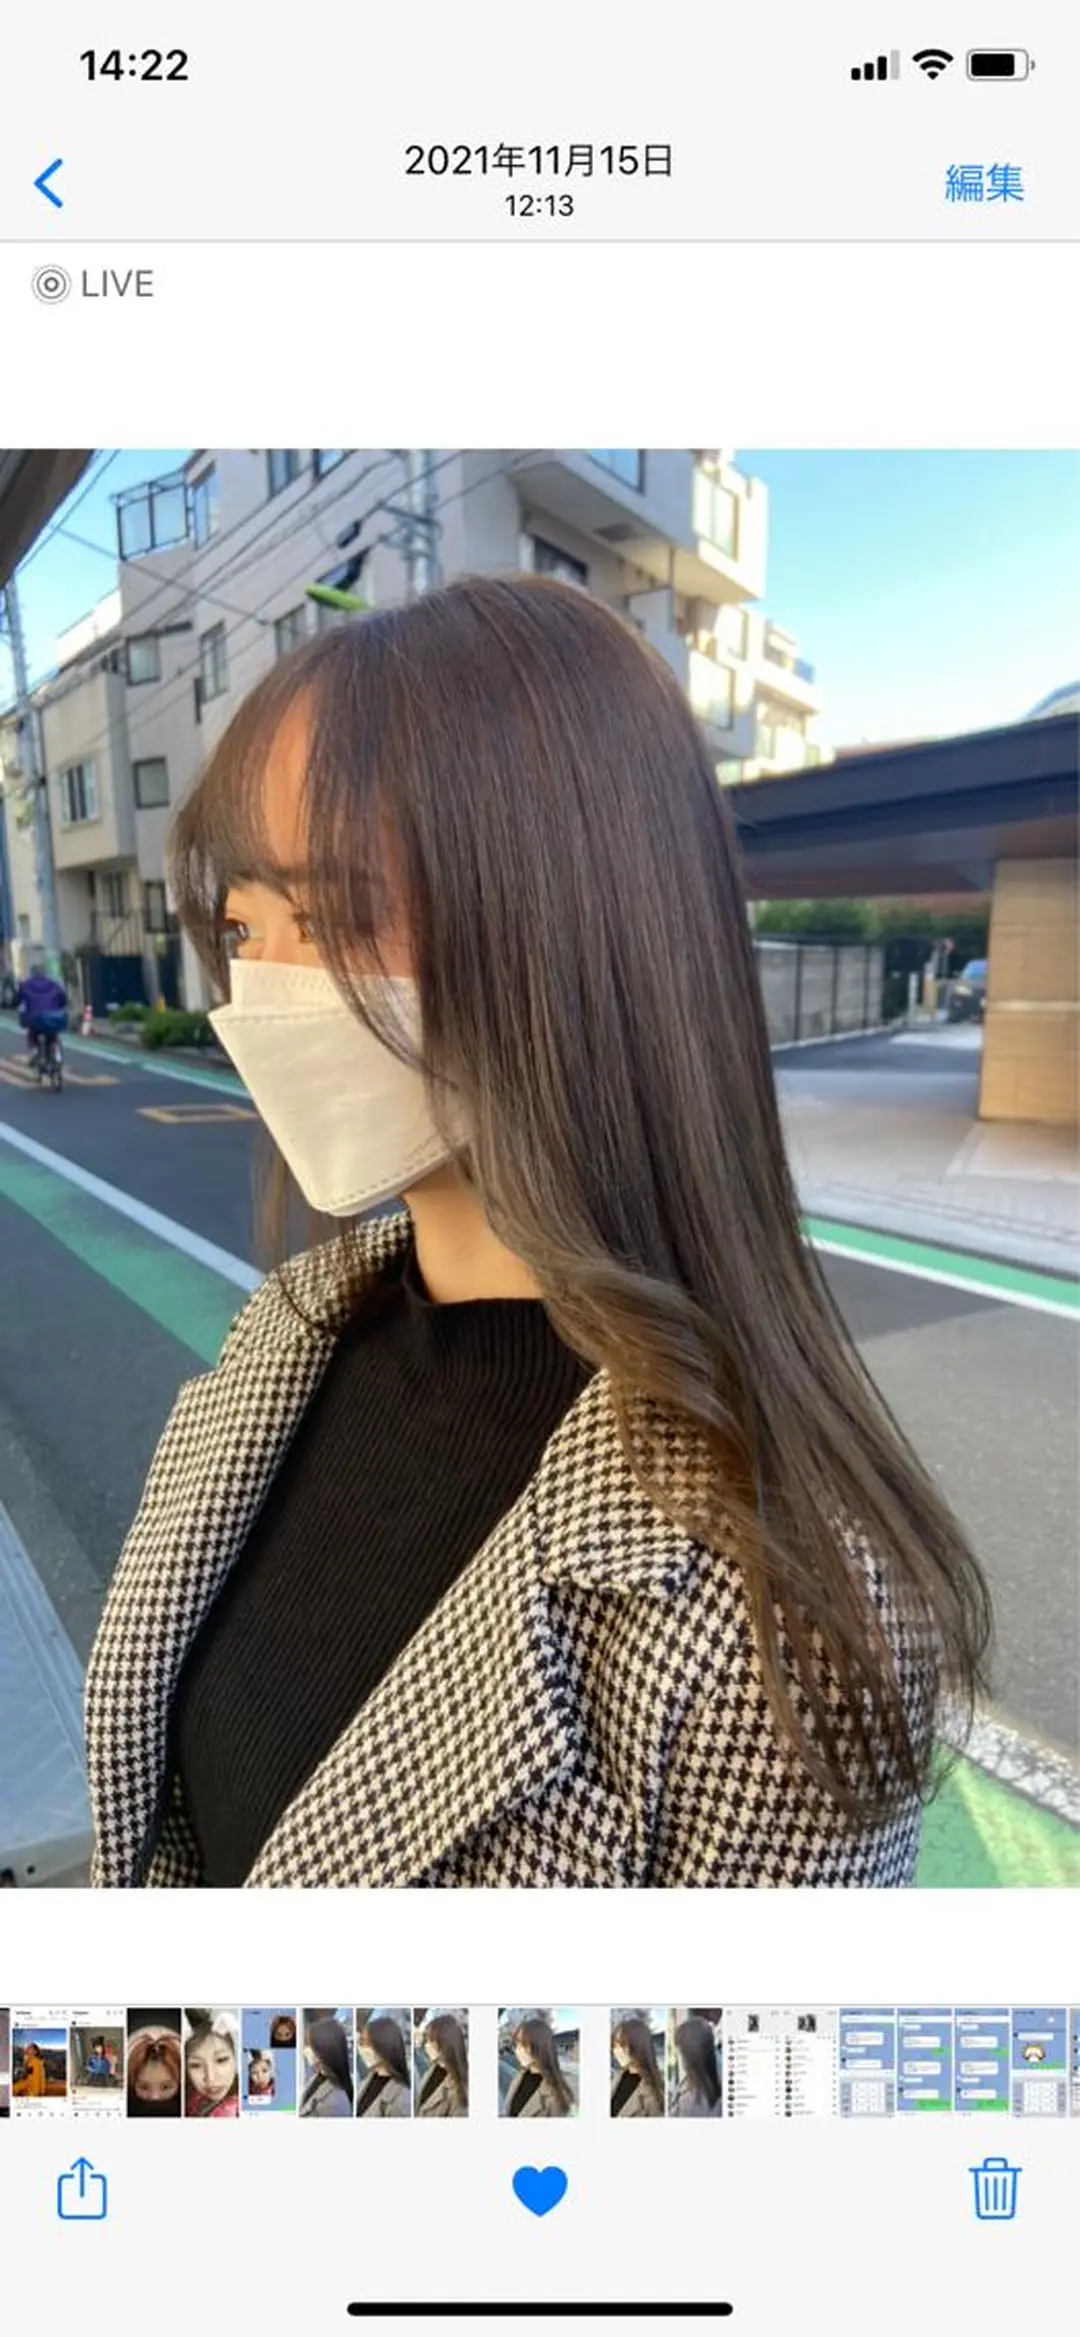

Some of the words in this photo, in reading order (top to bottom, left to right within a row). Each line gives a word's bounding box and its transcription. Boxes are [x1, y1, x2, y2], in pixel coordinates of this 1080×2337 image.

[80, 48, 189, 82] 14:22
[404, 141, 673, 178] 2021年11月15日
[944, 162, 1026, 204] 編集
[504, 193, 575, 217] 12:13
[81, 269, 154, 298] LIVE
